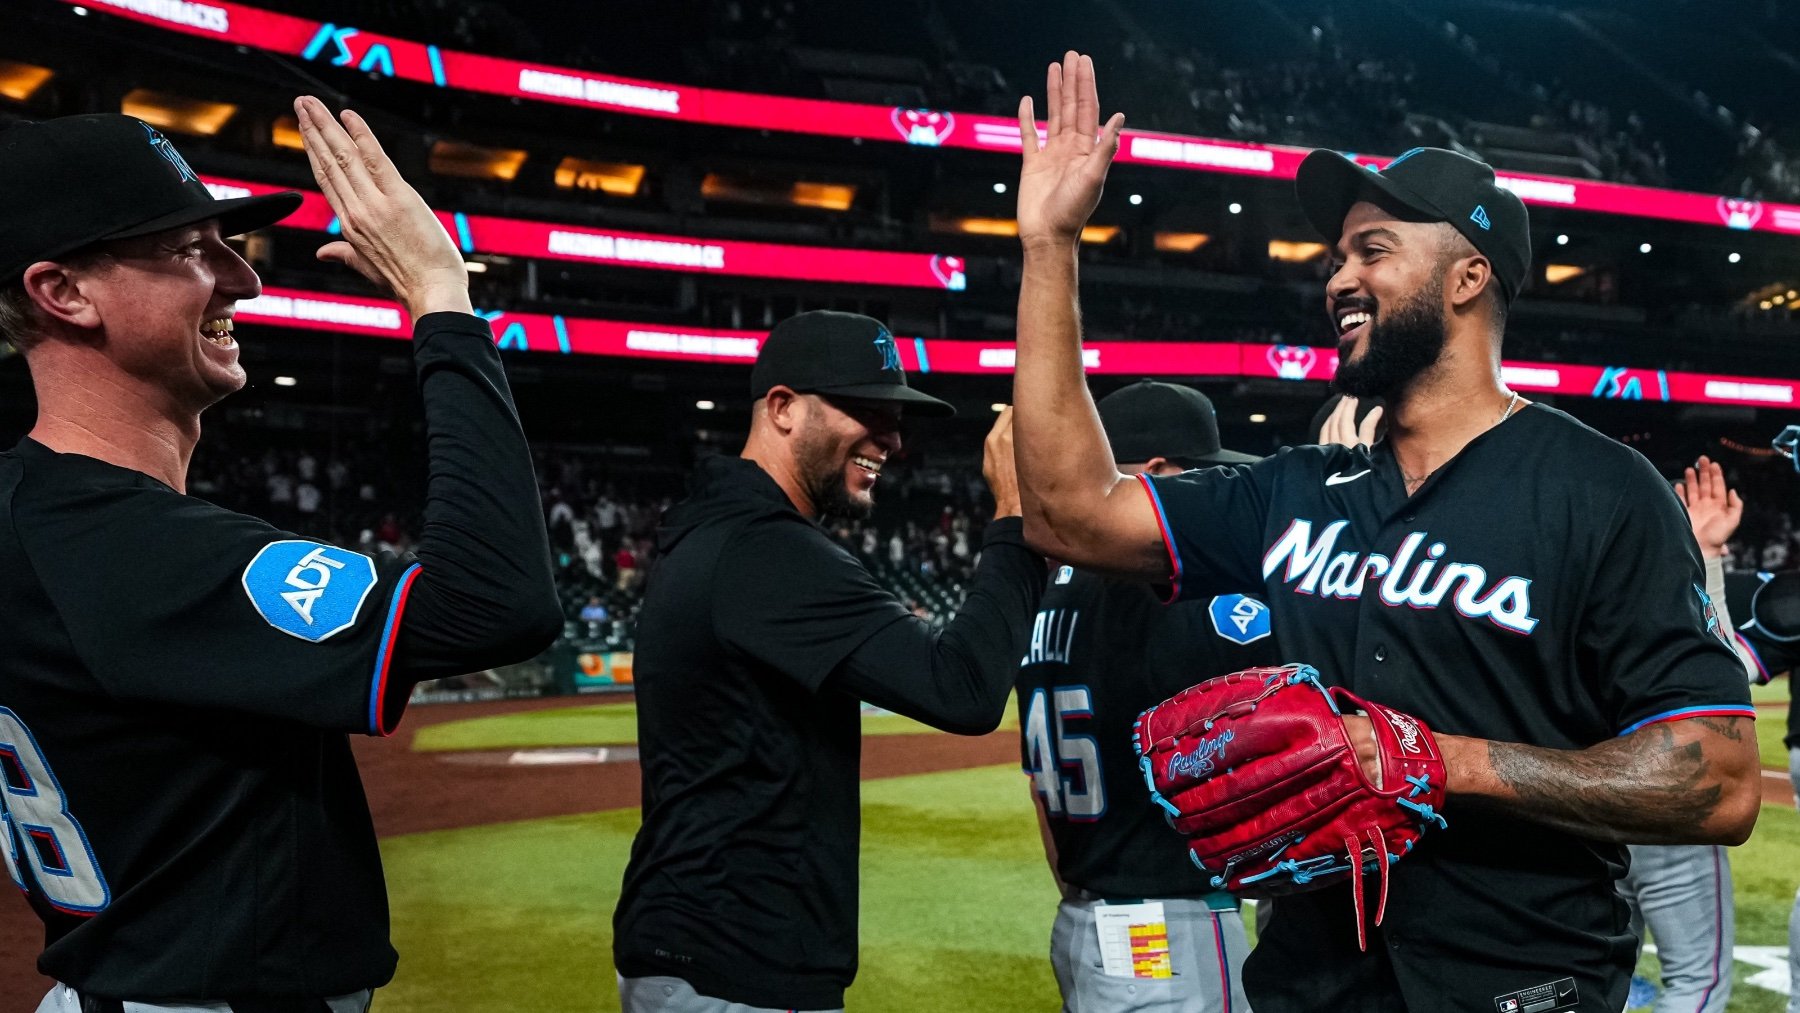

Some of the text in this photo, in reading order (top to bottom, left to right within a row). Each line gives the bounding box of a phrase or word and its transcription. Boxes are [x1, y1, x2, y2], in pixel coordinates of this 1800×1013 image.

[280, 547, 346, 626] ADT
[1262, 517, 1540, 635] Marlins
[1020, 609, 1079, 667] ALLI
[1025, 685, 1108, 823] 45
[1168, 729, 1235, 781] Rawlings
[0, 706, 111, 907] 8
